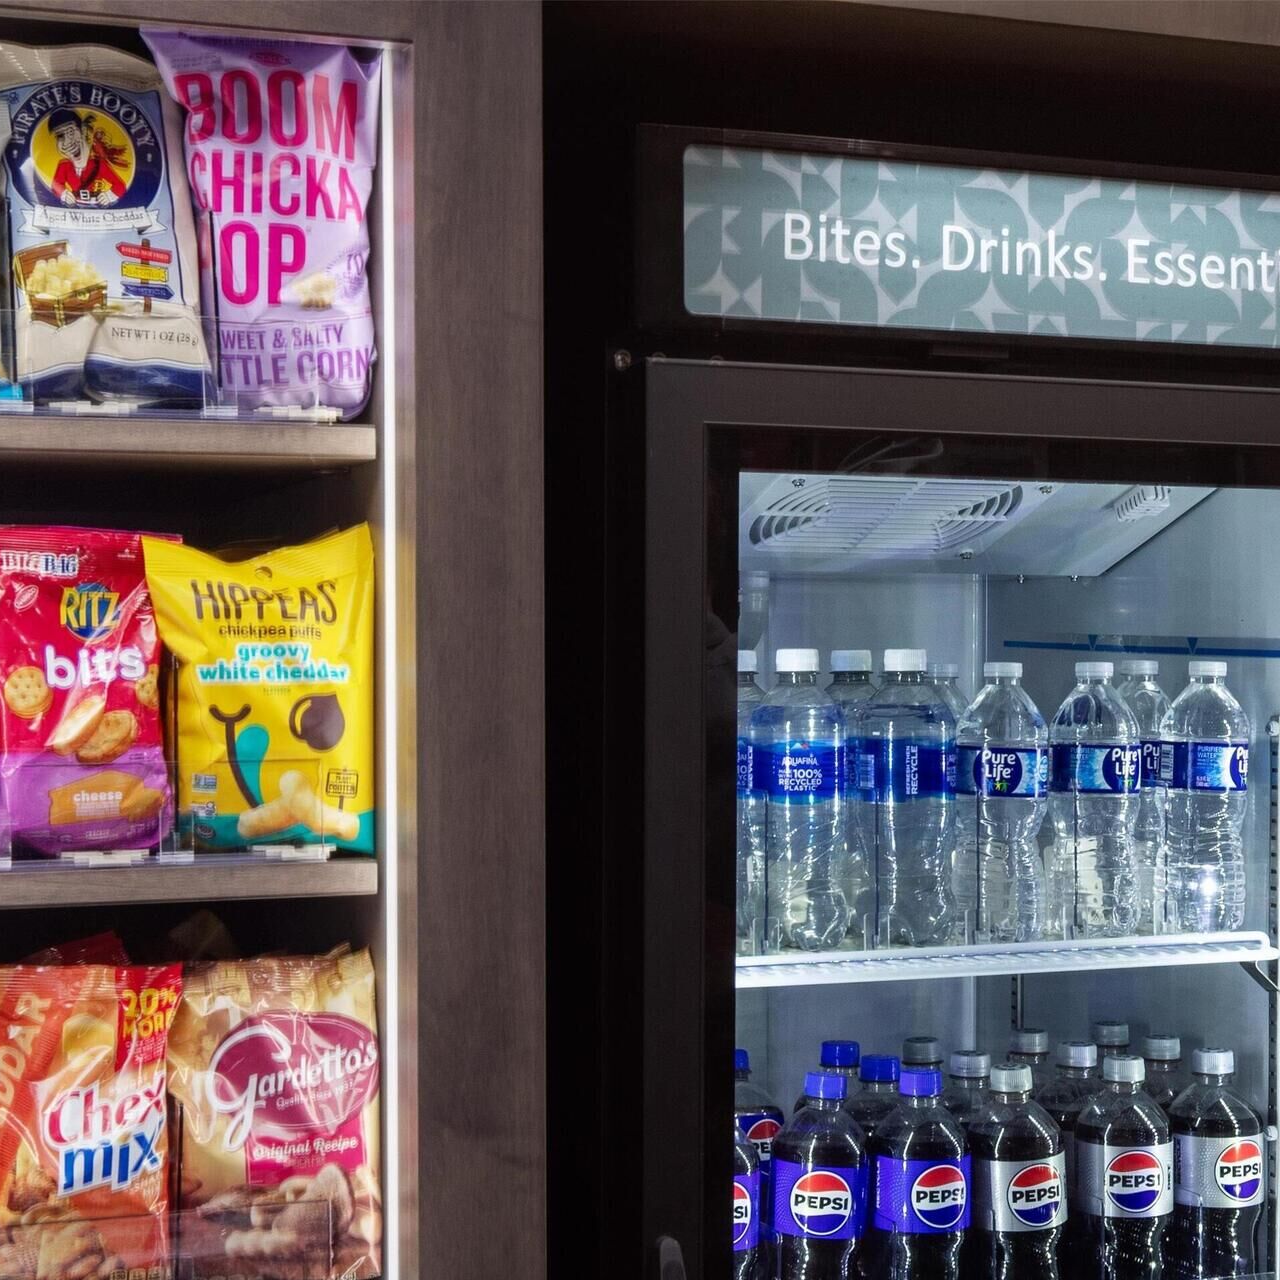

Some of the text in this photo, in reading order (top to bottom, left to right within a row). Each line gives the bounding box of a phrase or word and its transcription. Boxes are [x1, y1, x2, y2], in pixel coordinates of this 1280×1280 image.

[13, 85, 154, 148] PIRATE'S BOOTY
[175, 69, 358, 162] BOOM
[191, 150, 363, 223] CHICKA
[783, 212, 921, 269] Bites.
[942, 224, 1107, 282] Drinks.
[273, 325, 344, 349] & SALTY
[297, 347, 371, 387] CORN
[60, 587, 121, 629] RITZ
[191, 579, 337, 625] HIPPEAS
[219, 622, 287, 640] chickpea
[237, 644, 310, 662] groovy
[45, 645, 146, 688] bits
[199, 661, 348, 682] white cheddar
[782, 756, 818, 767] AQUAFINA
[981, 750, 1016, 766] Pure
[1111, 749, 1138, 762] Pure
[792, 768, 823, 779] 100%
[984, 764, 1012, 779] Life
[73, 790, 123, 802] cheese
[207, 1024, 378, 1152] Gardetto's
[48, 1076, 165, 1144] Chex
[63, 1119, 163, 1190] mix
[253, 1133, 358, 1160] Original Recipe
[1108, 1174, 1161, 1188] PEPSI
[1219, 1164, 1262, 1178] PEPSI
[793, 1193, 849, 1211] PEPSI
[915, 1186, 965, 1204] PEPSI
[1011, 1185, 1060, 1203] PEPSI
